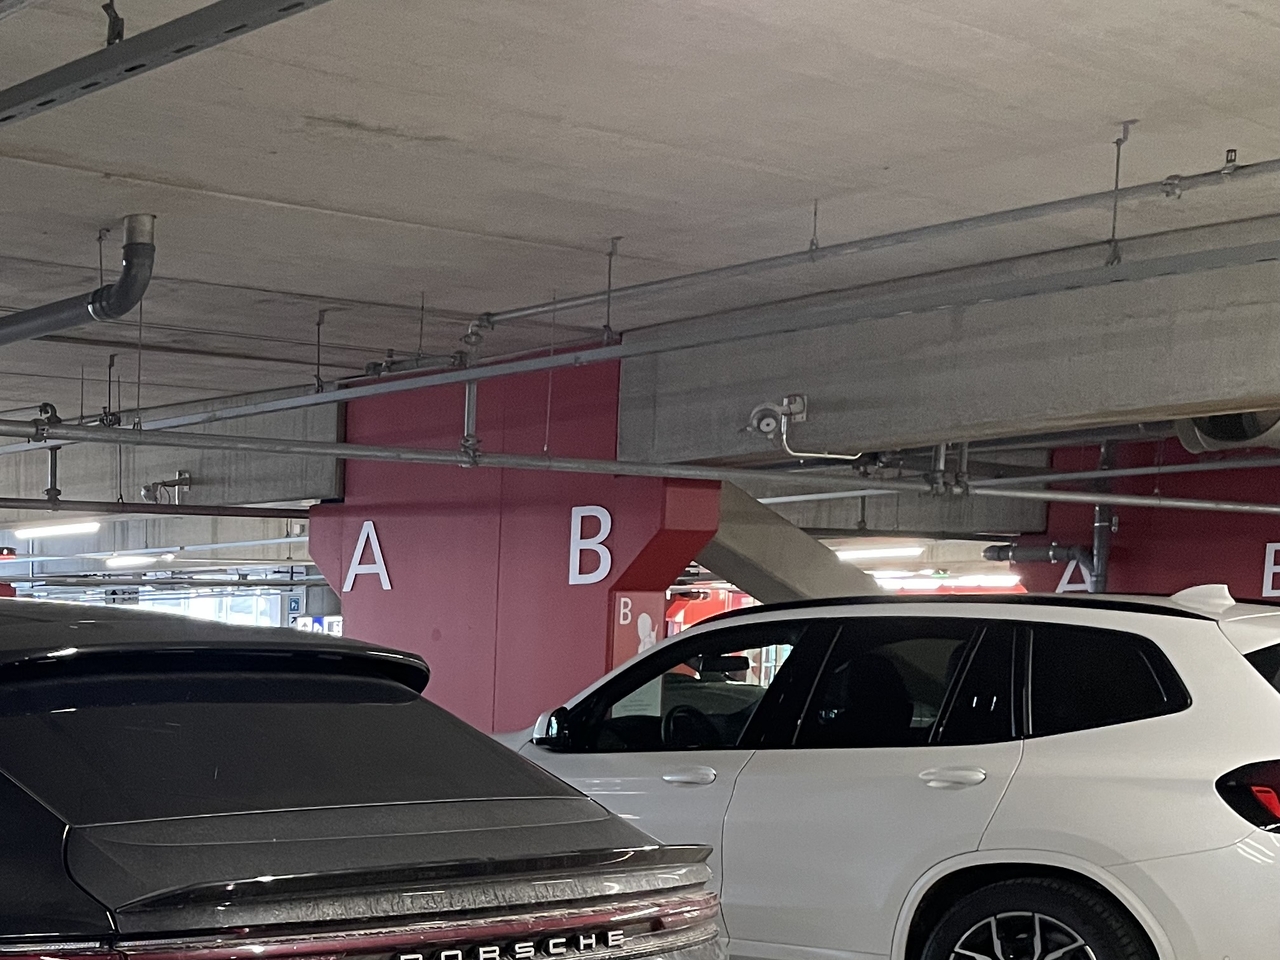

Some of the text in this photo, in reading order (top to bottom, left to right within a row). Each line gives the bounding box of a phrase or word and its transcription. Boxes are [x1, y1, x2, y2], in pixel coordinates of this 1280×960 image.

[342, 520, 392, 592] A
[568, 504, 613, 586] B
[1055, 558, 1093, 594] A
[619, 597, 632, 625] B
